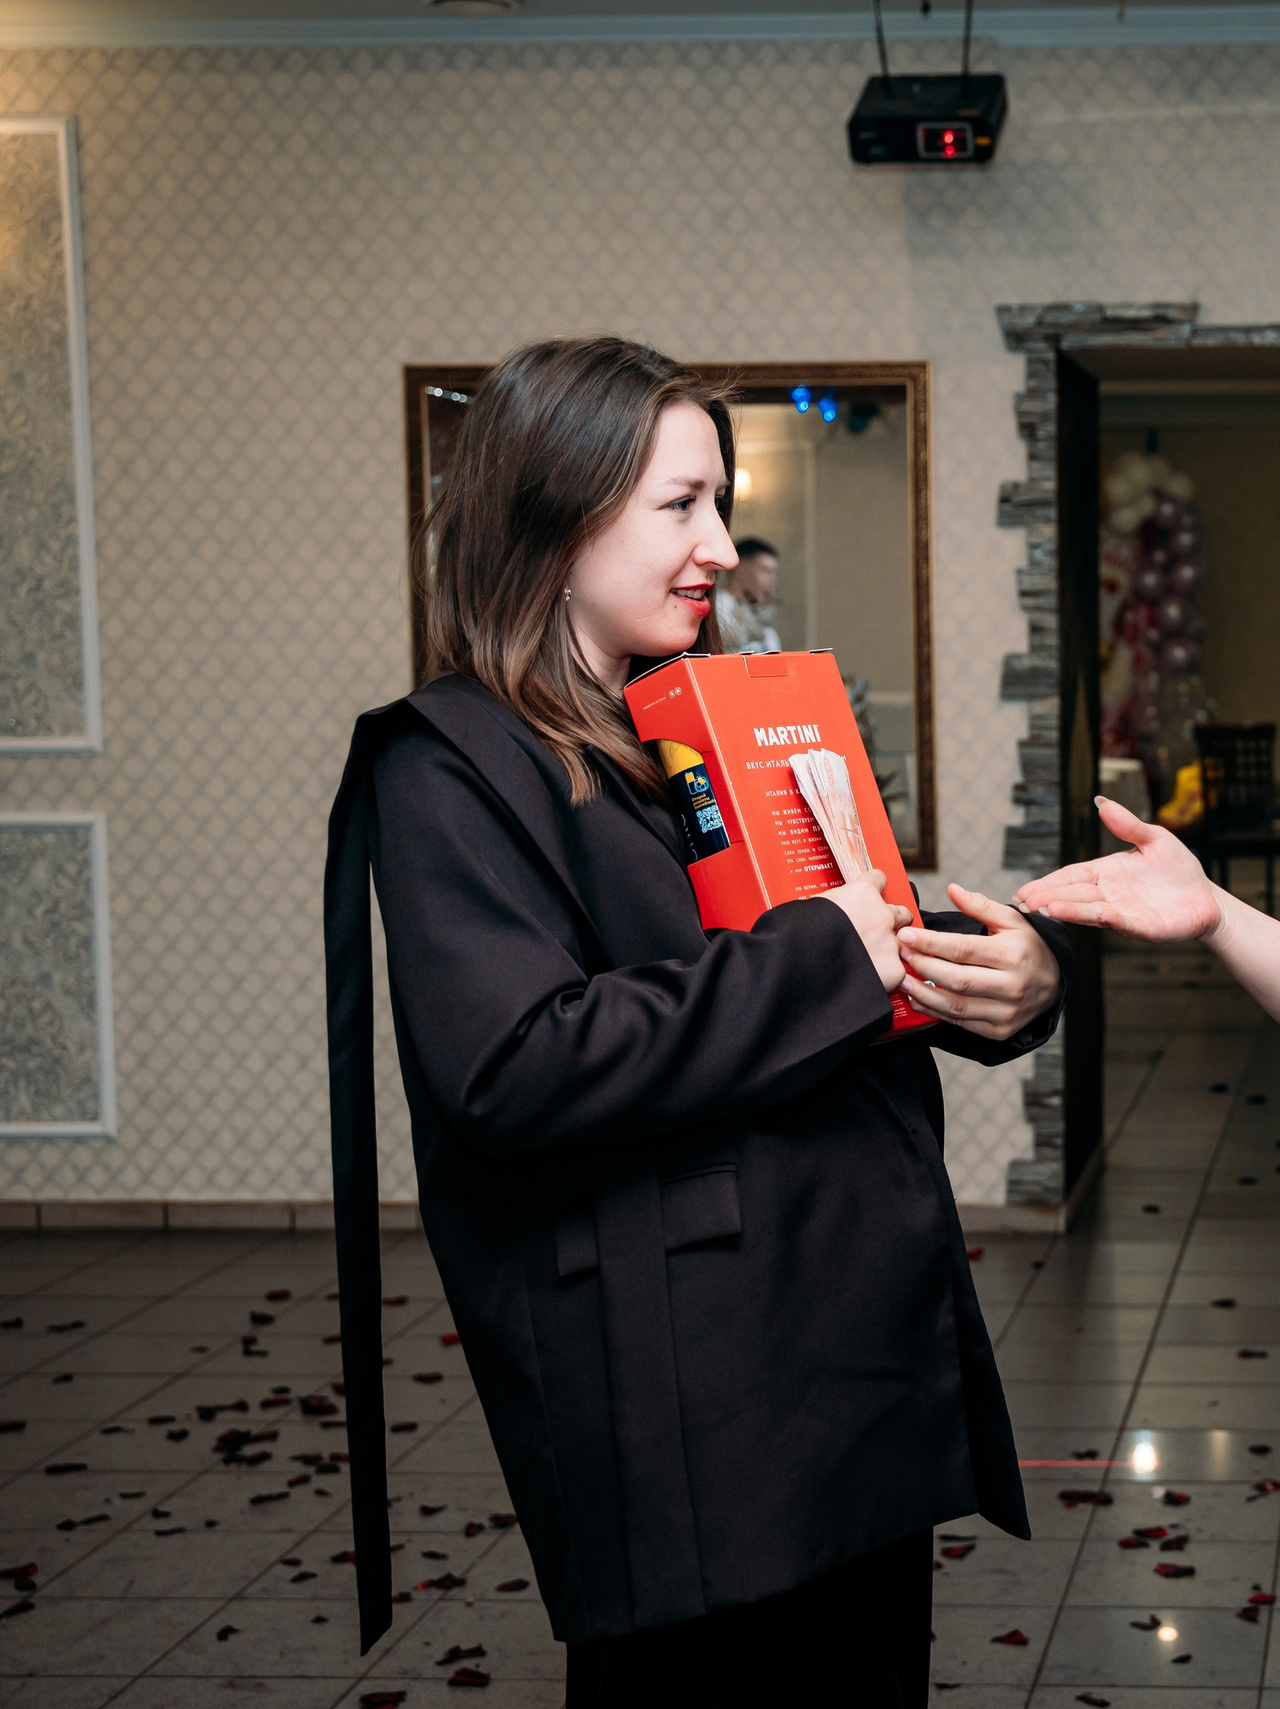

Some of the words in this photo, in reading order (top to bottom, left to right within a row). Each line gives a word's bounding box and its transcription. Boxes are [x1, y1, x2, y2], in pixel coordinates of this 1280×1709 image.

[753, 724, 822, 747] MARTINI
[746, 761, 764, 770] ВКУС
[765, 759, 790, 768] ИТАЛЬ
[804, 863, 834, 872] ОТКРЫВАЕТ
